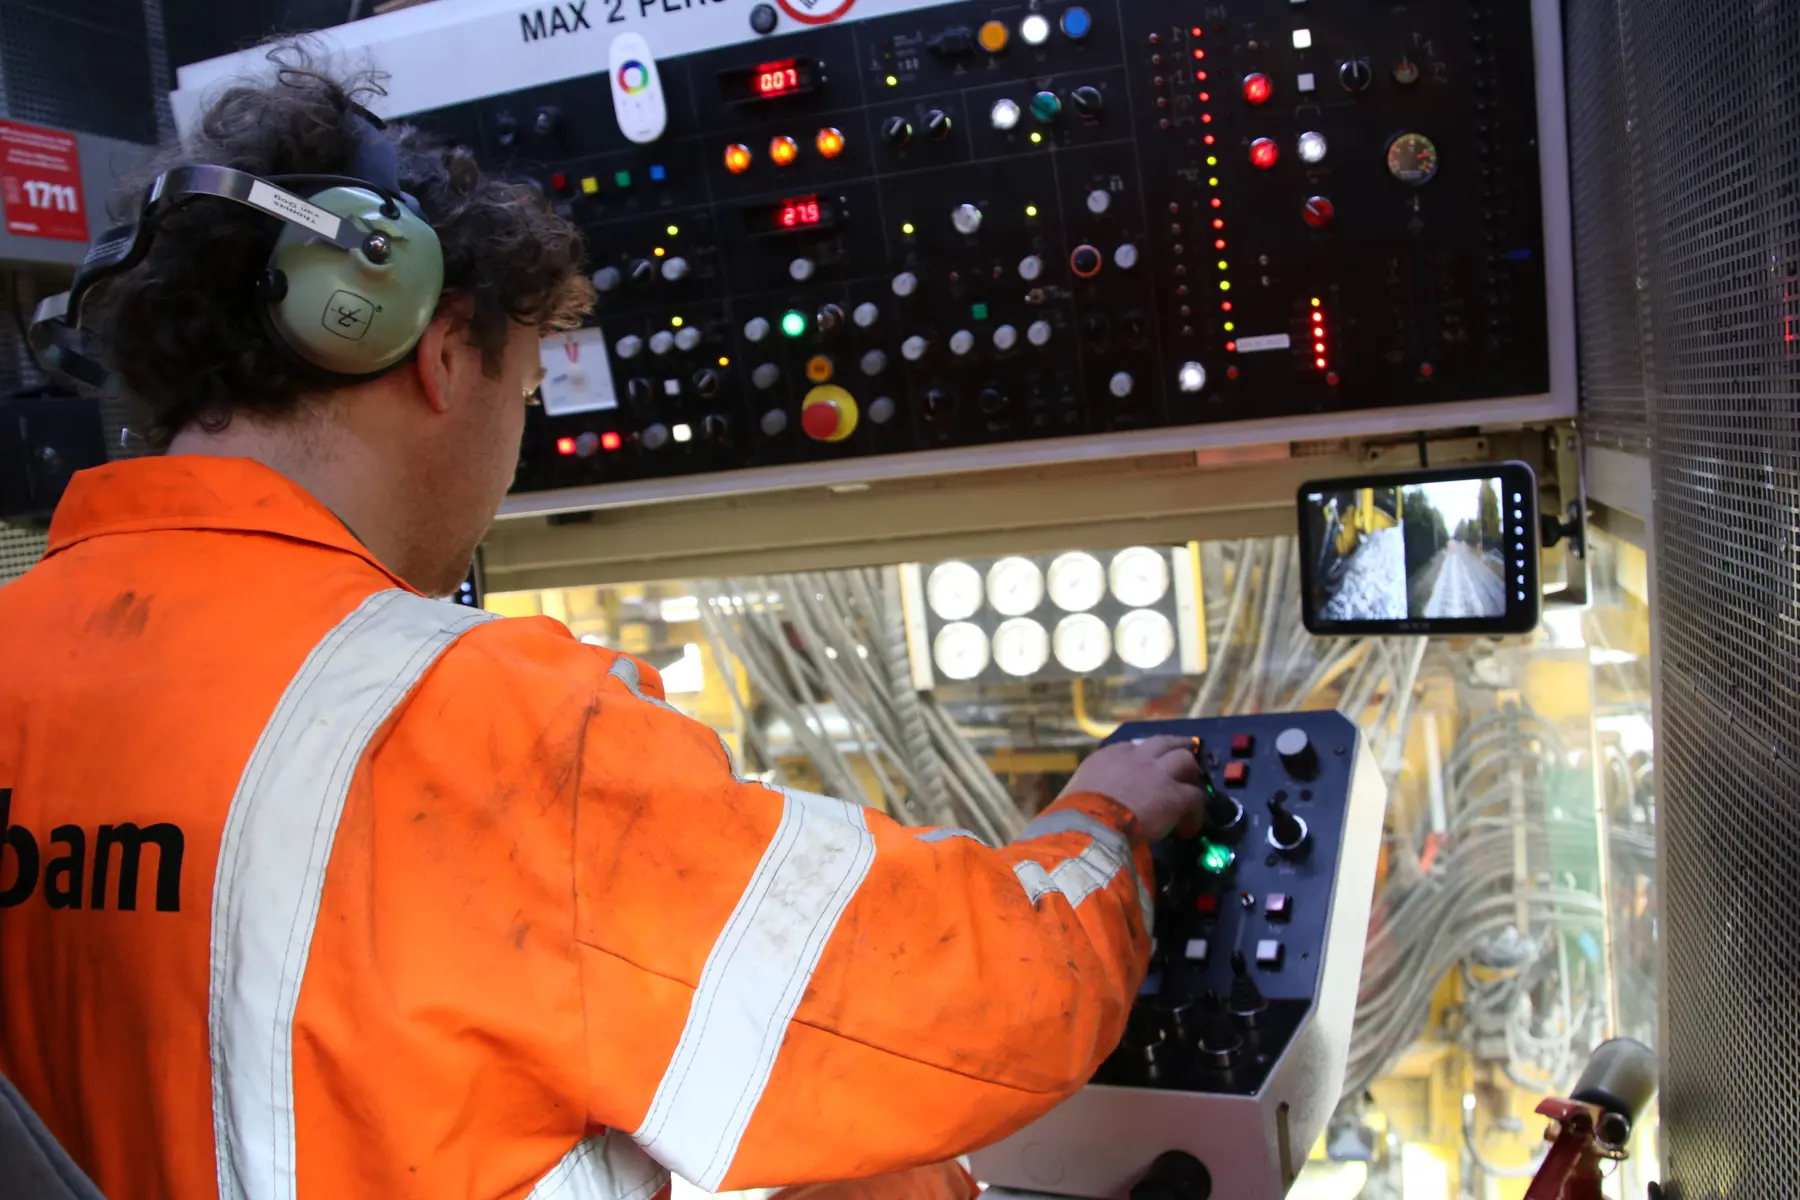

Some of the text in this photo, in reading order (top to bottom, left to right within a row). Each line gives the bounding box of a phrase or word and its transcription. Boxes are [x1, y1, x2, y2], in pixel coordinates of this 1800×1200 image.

[520, 0, 591, 42] MAX
[604, 0, 626, 23] 2
[23, 180, 78, 213] 17m
[0, 788, 185, 912] bam
